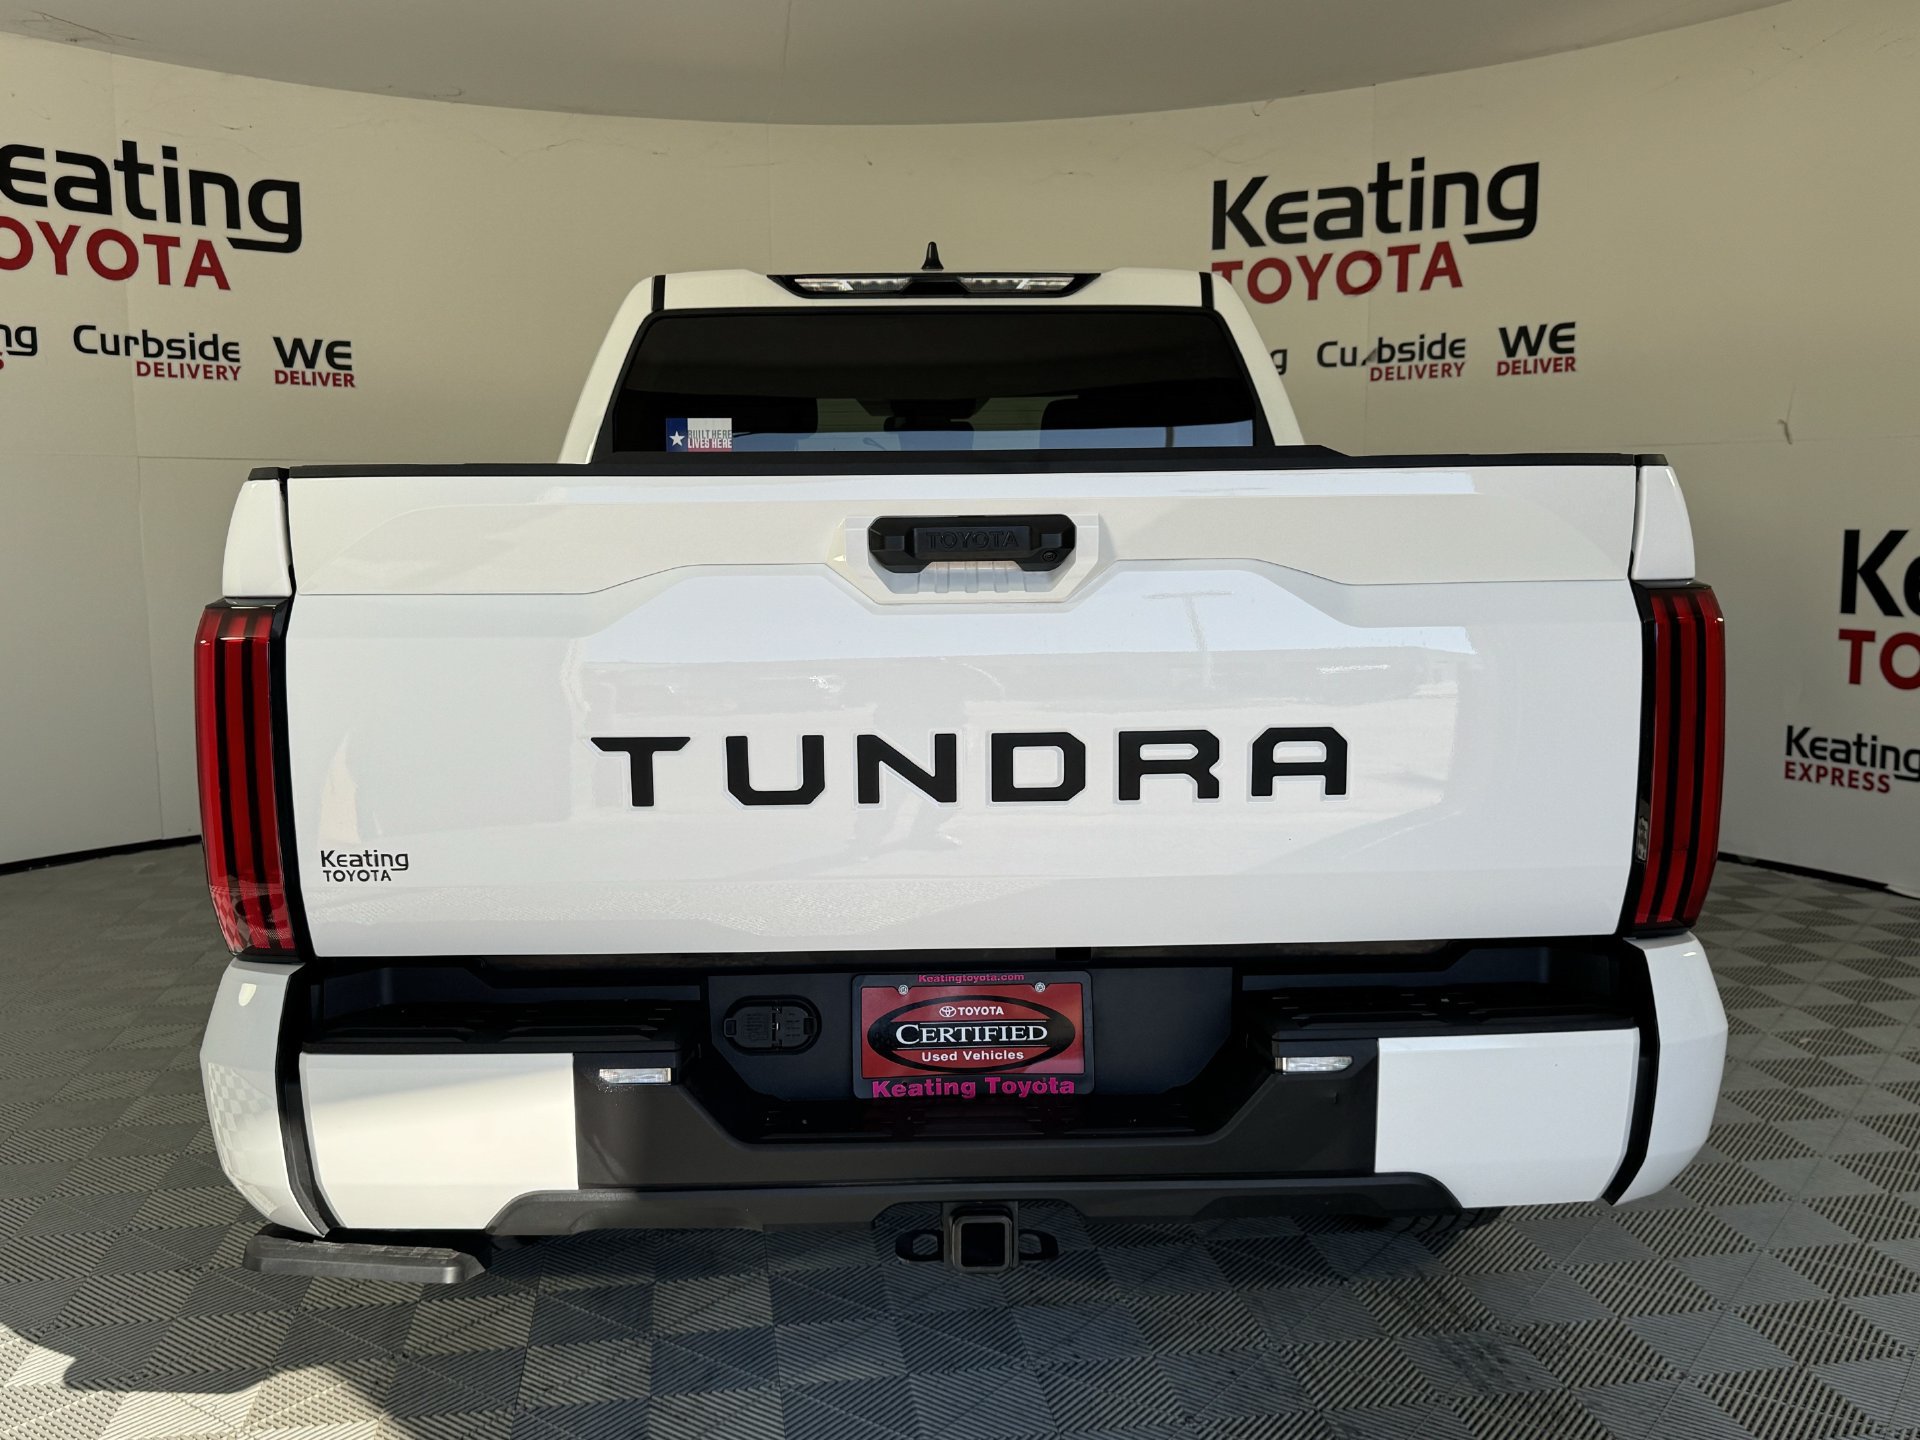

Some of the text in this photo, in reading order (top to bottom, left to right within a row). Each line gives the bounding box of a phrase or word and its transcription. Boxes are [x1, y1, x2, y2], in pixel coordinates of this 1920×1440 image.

[1211, 156, 1540, 250] Keating
[73, 324, 241, 363] Curbside
[1316, 332, 1466, 368] Cubside
[136, 360, 242, 381] DELIVERY
[1369, 362, 1466, 382] DELIVERY
[1496, 356, 1577, 377] DELIVER
[274, 369, 356, 388] DELIVER
[688, 430, 732, 439] BUILT HERE
[688, 439, 732, 449] LIVES HERE
[925, 530, 1020, 550] TOYOTA
[1785, 725, 1920, 783] Keating
[590, 726, 1349, 808] TUNDRA
[1783, 760, 1892, 794] EXPRESS
[320, 849, 409, 871] Keating
[322, 869, 392, 882] TOYOTA
[918, 973, 1025, 985] Keatingtoyota.com
[957, 1006, 1005, 1016] TOYOTA
[895, 1024, 1048, 1045] CERTIFIED
[921, 1050, 1024, 1062] Used Vehicles
[871, 1076, 1075, 1099] Keating Toyota
